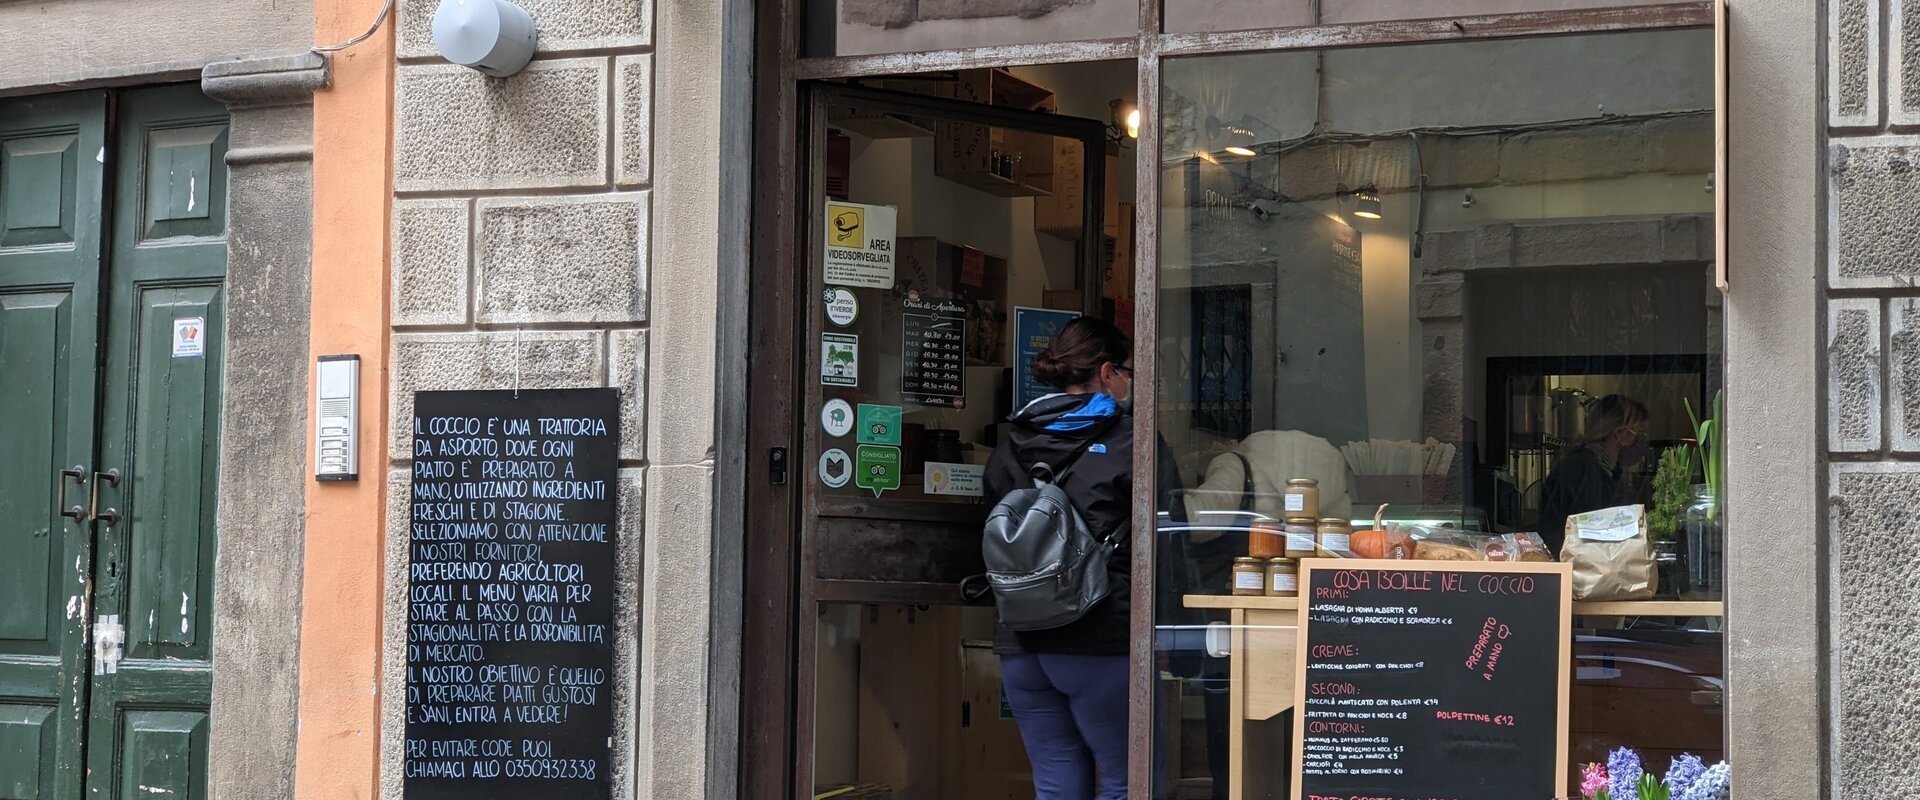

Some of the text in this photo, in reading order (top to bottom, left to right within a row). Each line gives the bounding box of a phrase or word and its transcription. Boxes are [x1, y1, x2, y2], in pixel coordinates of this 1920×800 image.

[870, 239, 890, 251] AREA
[828, 249, 890, 264] VIDEOSORVEGLIATA
[904, 299, 922, 308] Orari
[931, 301, 965, 313] Apertura
[415, 417, 425, 435] IL
[429, 417, 480, 435] COCCIO
[503, 418, 531, 436] UNA
[538, 418, 607, 436] TRATTORIA
[415, 438, 574, 459] DA ASPORTO, DOVE OGNI
[861, 451, 897, 459] CONSIGLIATO
[415, 461, 455, 478] PIATTO
[482, 461, 556, 478] PREPARATO
[564, 462, 575, 478] A
[414, 480, 605, 502] MANO, UTILIZZANDO INGREDIENTI
[413, 502, 570, 521] FRESCHI E DI STAGIONE.
[411, 523, 608, 543] SELEZIONIAMO CON ATTENZIONE
[412, 544, 416, 561] I
[420, 542, 467, 561] NOSTRI
[411, 563, 491, 582] PREFERENDO
[1333, 570, 1534, 595] COSA BOLLE NEL COCCIO
[411, 585, 456, 602] LOCALI.
[462, 585, 472, 601] IL
[522, 584, 558, 602] VARIA
[566, 584, 592, 603] PER
[1316, 587, 1349, 599] PRIMI:
[410, 604, 577, 623] STARE AL PASSO CON LA
[504, 625, 511, 642] E
[514, 625, 527, 641] LA
[409, 644, 486, 662] DI MERCATO.
[1312, 645, 1359, 658] CREME:
[1466, 617, 1496, 670] PREPARATO
[1487, 643, 1502, 671] MANO
[408, 666, 417, 683] IL
[422, 665, 473, 683] NOSTRO
[479, 664, 541, 684] OBIETTIVO
[560, 668, 605, 685] QUELLO
[409, 684, 596, 705] DI PREPARARE PIATTI GUSTOSI
[1312, 682, 1360, 695] SECONDI:
[1423, 698, 1438, 706] €14
[408, 707, 415, 724] E
[419, 705, 452, 725] SANI,
[456, 706, 497, 724] ENTRA
[503, 707, 512, 723] A
[1436, 711, 1515, 726] POLPETTINE €12
[1309, 721, 1365, 733] CONTORNI:
[407, 739, 551, 758] PER EVITARE CODE PUOI
[406, 759, 596, 780] CHIAMACI ALLO 0350932338
